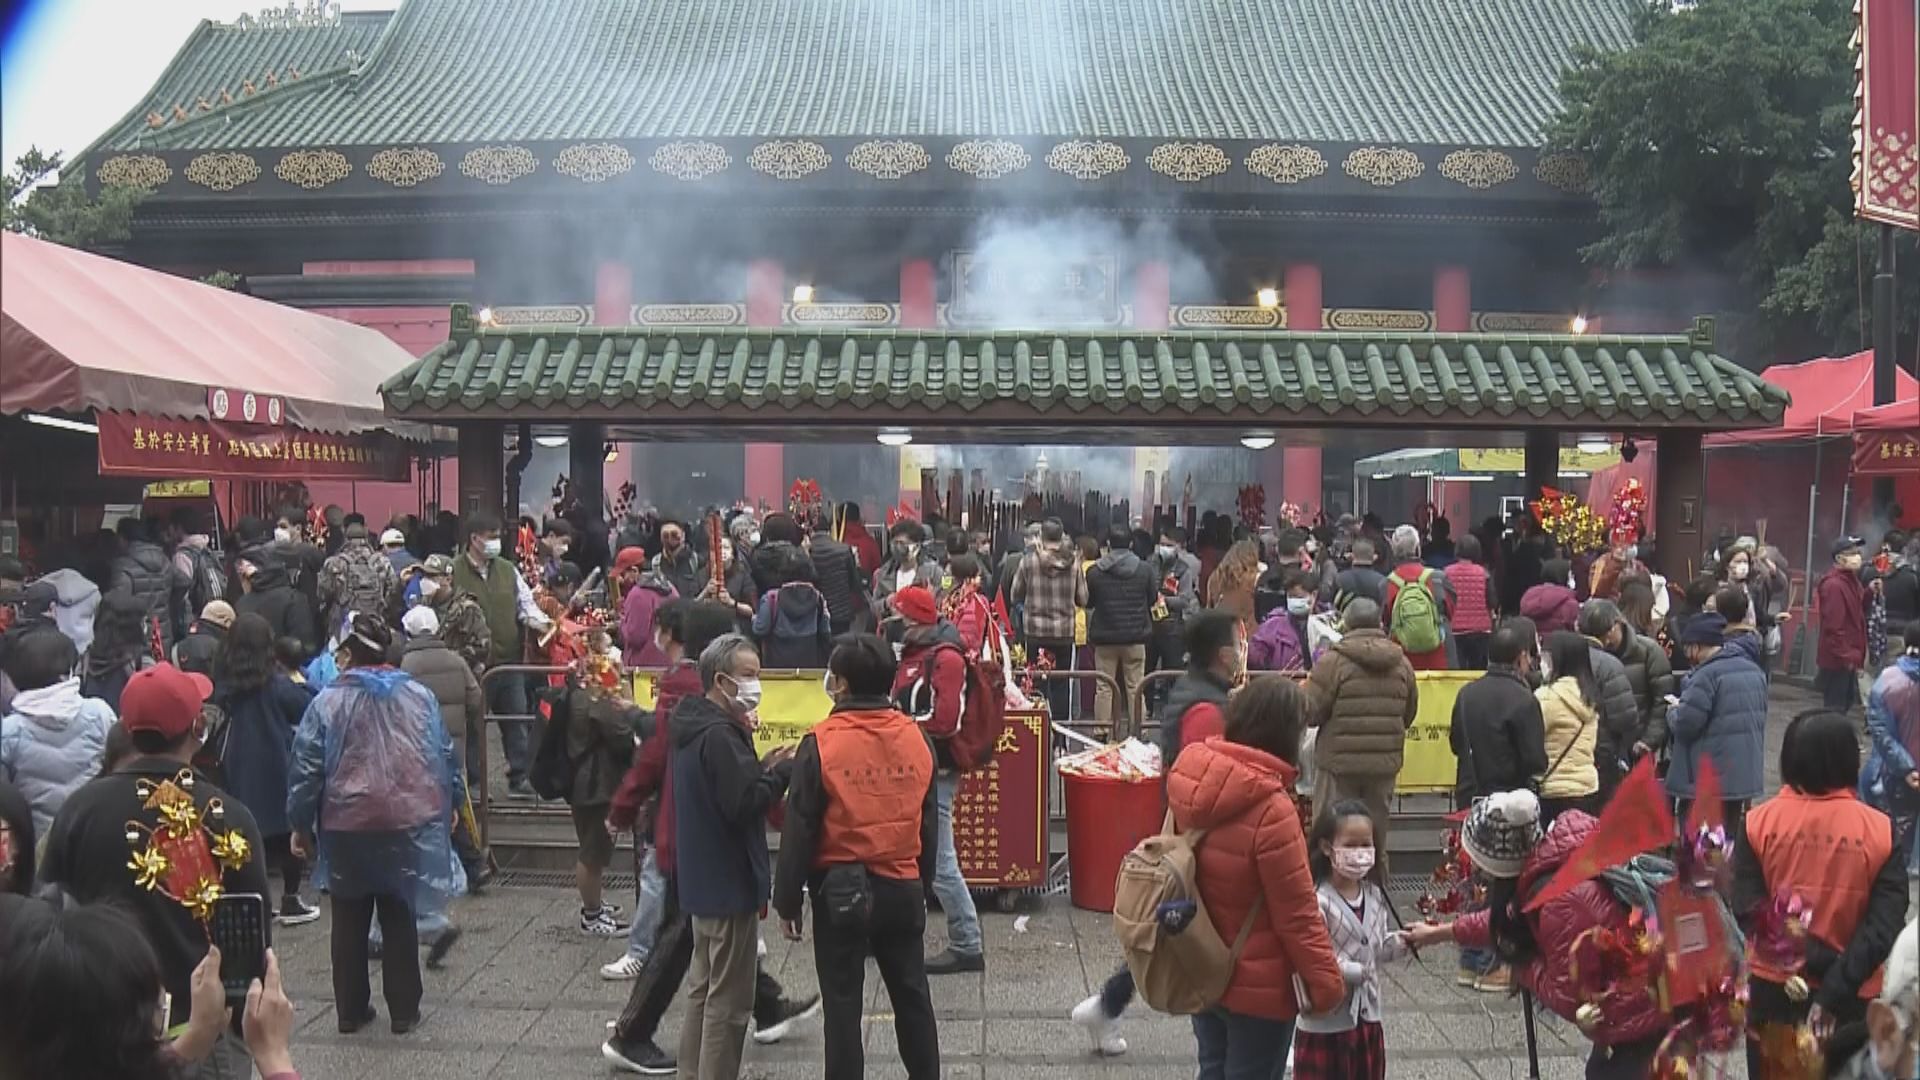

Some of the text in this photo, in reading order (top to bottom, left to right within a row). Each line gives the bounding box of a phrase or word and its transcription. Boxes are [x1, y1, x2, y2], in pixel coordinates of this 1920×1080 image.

[986, 269, 1087, 297] 車公
[1880, 441, 1920, 459] 基於安
